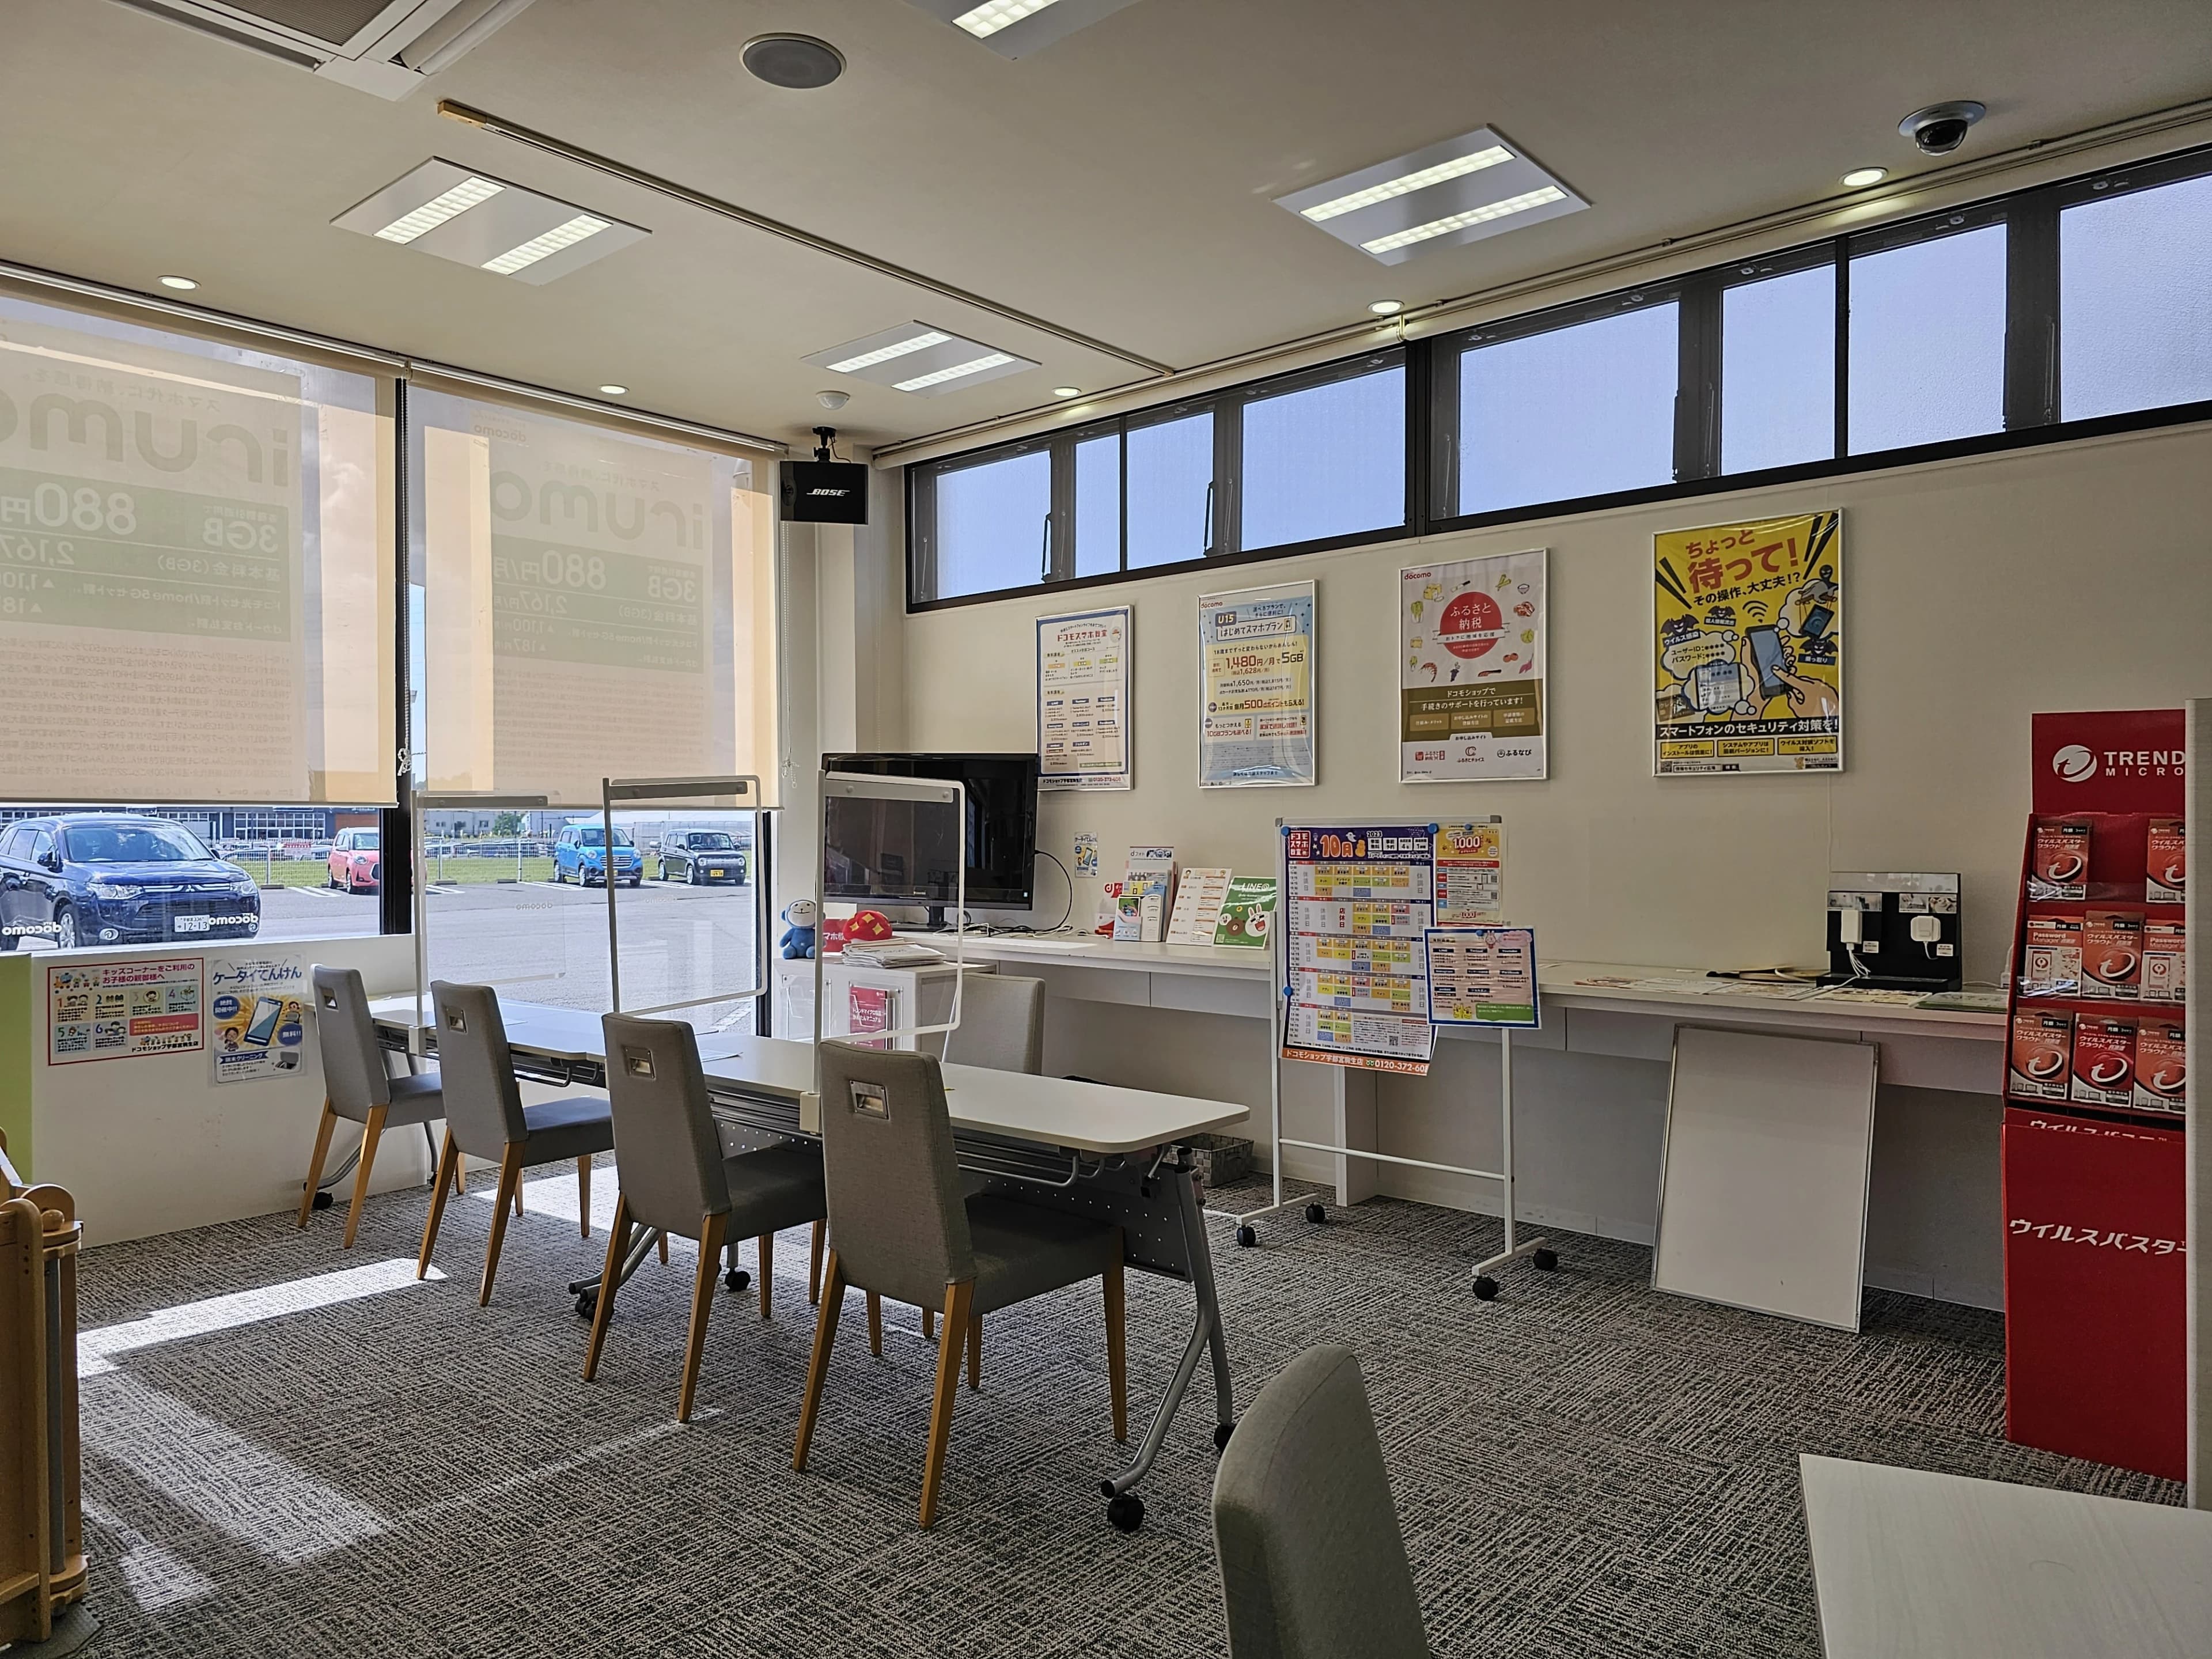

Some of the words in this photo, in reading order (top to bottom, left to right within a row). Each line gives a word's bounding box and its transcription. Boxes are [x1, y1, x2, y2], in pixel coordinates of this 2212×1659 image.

[1685, 529, 1755, 559] ちょっと
[1687, 537, 1798, 594] 待って!
[1404, 571, 1431, 580] docomo
[1694, 572, 1801, 605] その操作、大丈夫!?
[1450, 603, 1492, 617] ふるさと
[1218, 614, 1234, 624] U15
[1459, 616, 1482, 630] 納税
[1221, 622, 1283, 637] はじめてスマホプラン
[1447, 687, 1497, 698] ドコモショップで
[1421, 697, 1523, 711] 手続きのサポートを行っています!
[1660, 718, 1838, 737] スマートフォンのセキュリティ対策を!
[2104, 751, 2186, 766] TREND
[2105, 767, 2184, 777] MICRO
[1320, 834, 1353, 858] 10月
[1242, 882, 1270, 891] LINE@
[184, 922, 208, 931] 12-13
[103, 963, 195, 976] キッズコーナーをご利用の
[213, 966, 302, 986] ケータイてんけん
[96, 994, 102, 1005] 2
[133, 992, 139, 1002] 3
[168, 989, 176, 999] 4
[57, 998, 63, 1008] 1
[58, 1027, 65, 1037] 5
[95, 1024, 103, 1034] 6
